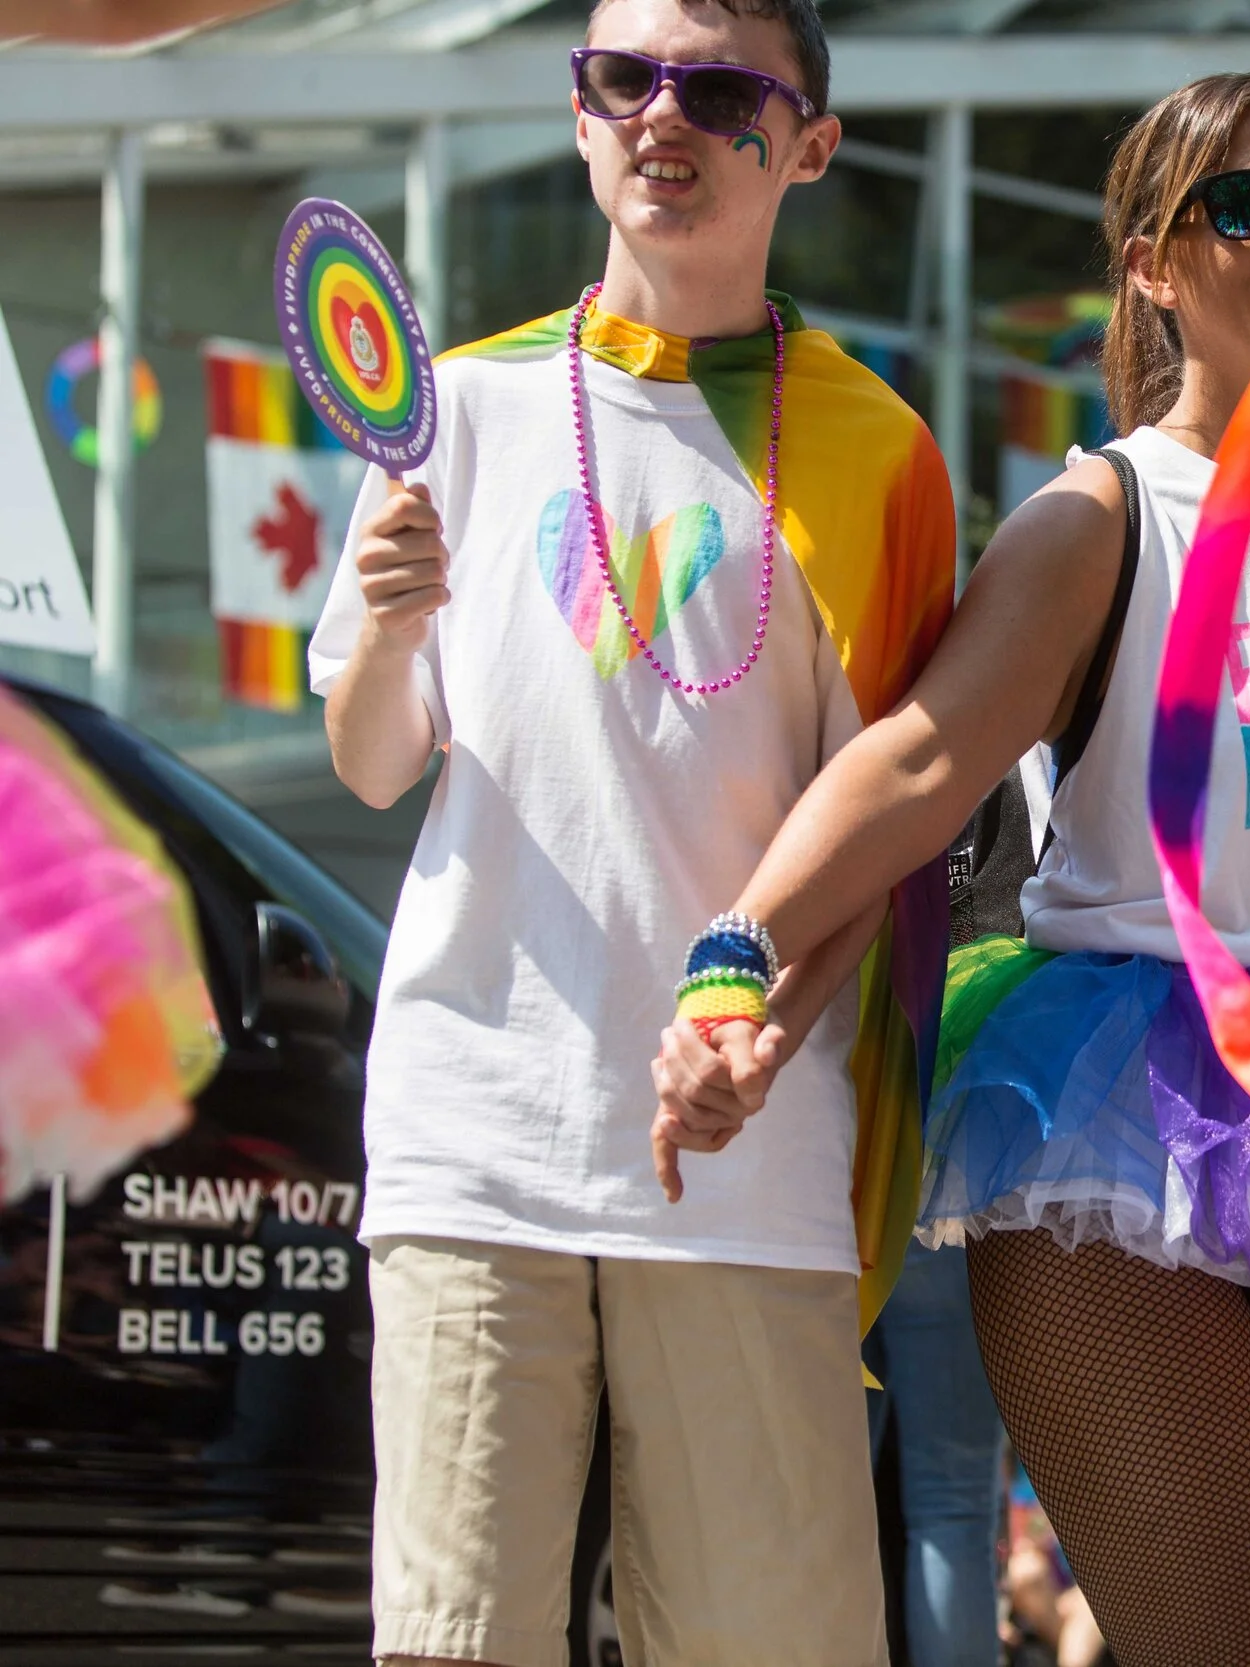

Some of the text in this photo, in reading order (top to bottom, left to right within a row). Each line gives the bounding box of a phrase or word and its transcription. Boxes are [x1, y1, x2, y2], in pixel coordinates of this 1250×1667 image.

[309, 213, 323, 229] IN
[323, 213, 348, 232] THE
[350, 225, 420, 336] COMMUNITY
[366, 437, 379, 455] IN
[382, 446, 408, 461] THE
[408, 365, 433, 456] COMMUNITY
[123, 1173, 359, 1227] SHAW 10/7
[121, 1241, 350, 1291] TELUS 123
[117, 1308, 326, 1356] BELL 656
